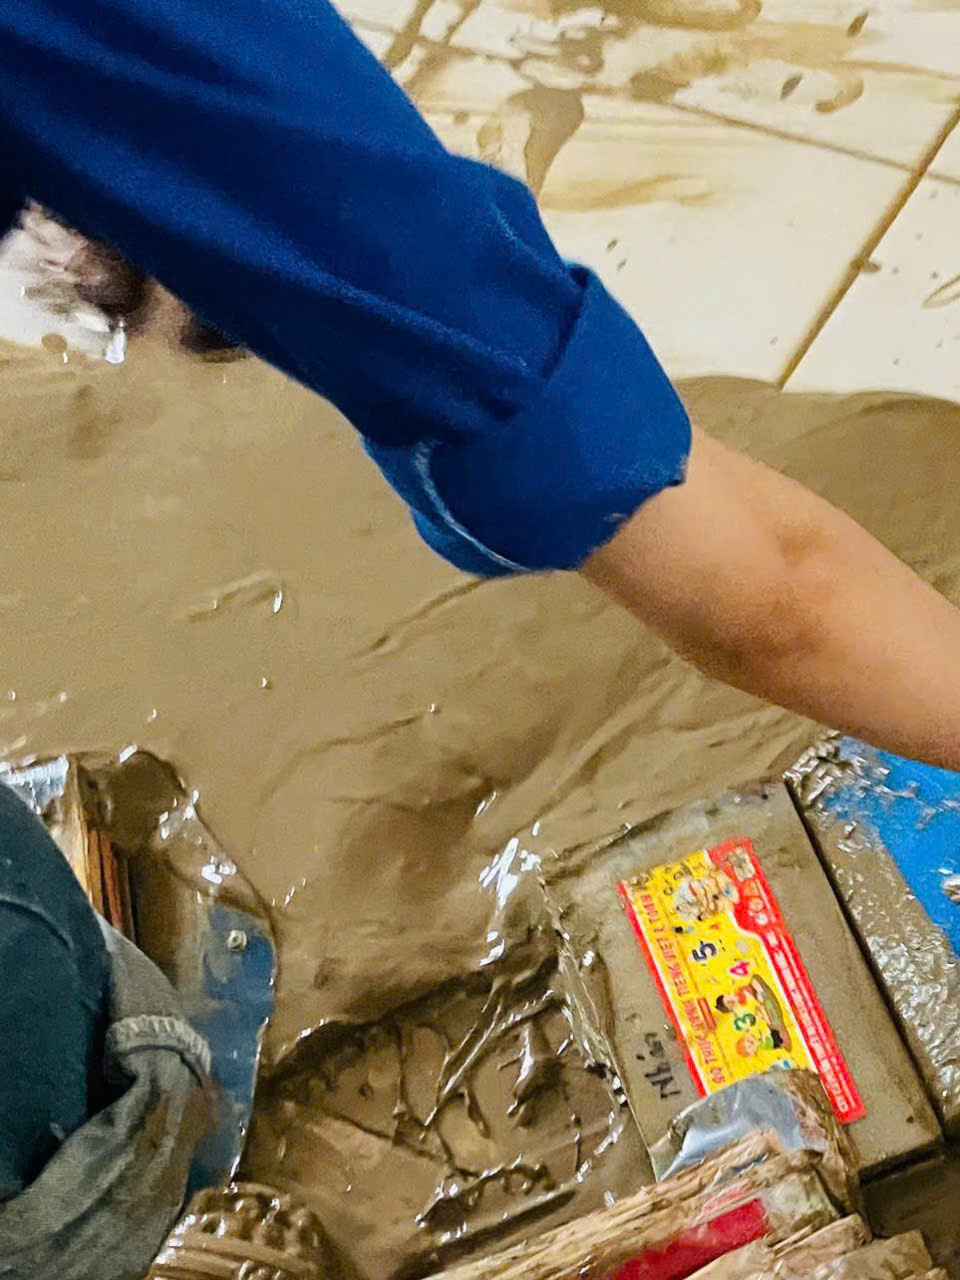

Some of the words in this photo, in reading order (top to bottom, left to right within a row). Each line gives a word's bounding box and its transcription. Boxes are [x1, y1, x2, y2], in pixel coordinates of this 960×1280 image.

[692, 940, 716, 961] 5
[730, 961, 750, 977] 4
[733, 1013, 755, 1032] 3
